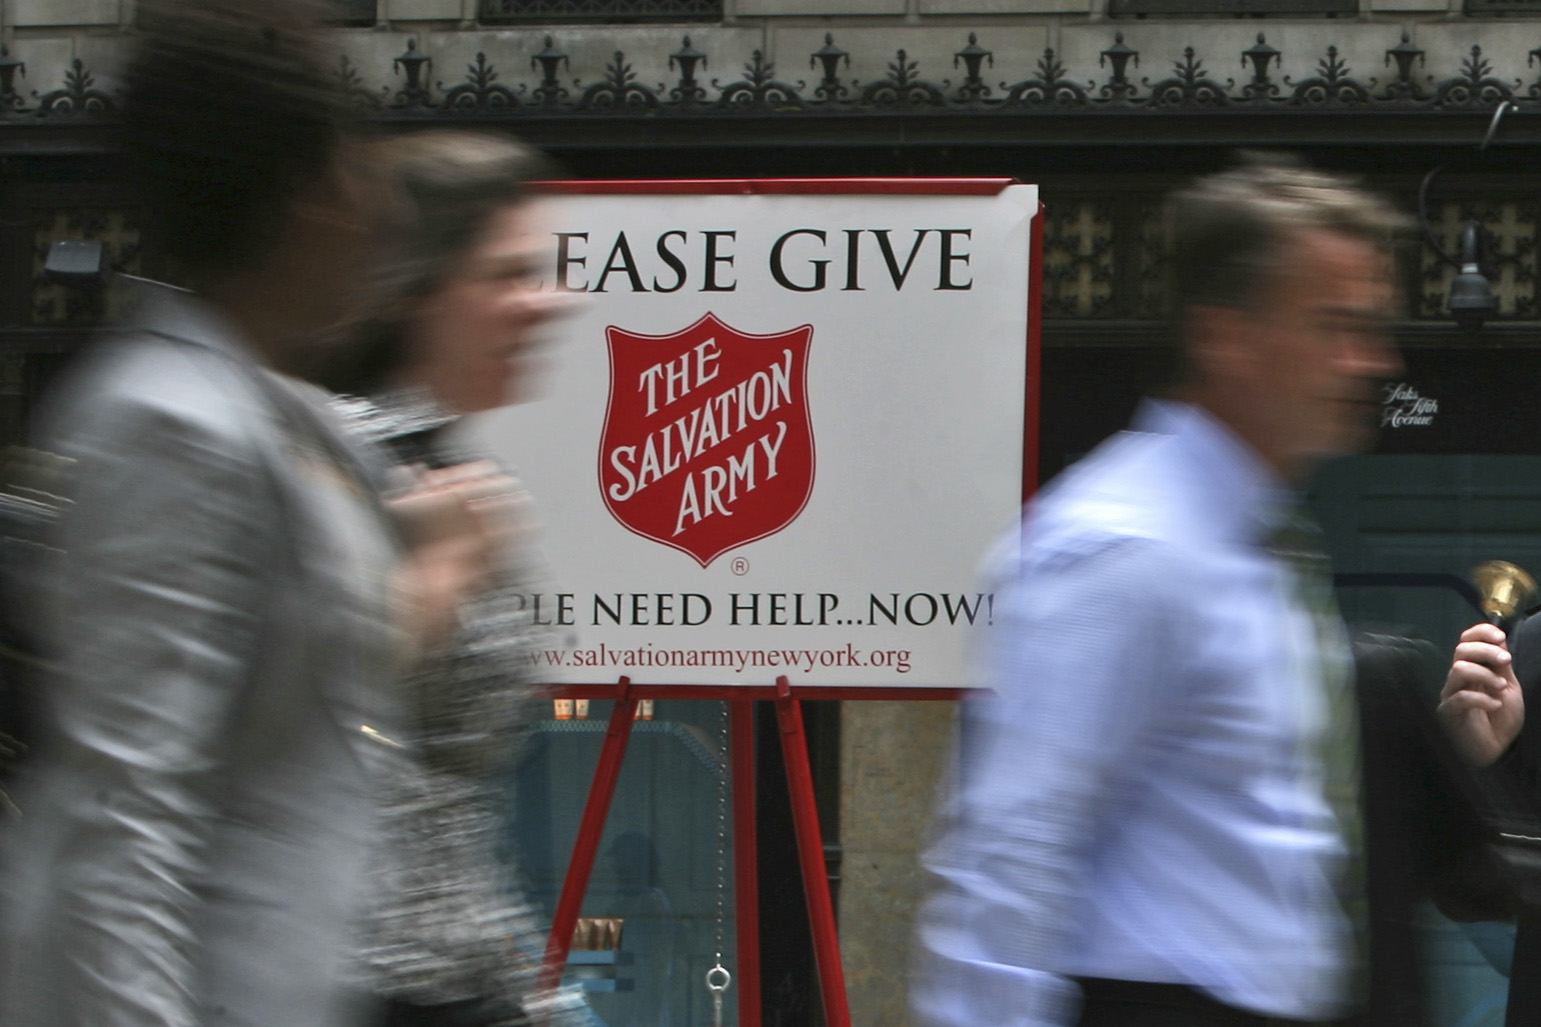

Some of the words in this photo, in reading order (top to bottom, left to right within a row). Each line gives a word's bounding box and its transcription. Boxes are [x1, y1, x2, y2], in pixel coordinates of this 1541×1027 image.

[536, 229, 738, 293] EASE
[769, 228, 974, 293] GIVE
[638, 337, 722, 418] THE
[1383, 384, 1418, 405] Saks
[609, 348, 793, 502] SALVATION
[1380, 406, 1434, 428] Avenue
[1403, 397, 1438, 416] Fifth
[671, 421, 788, 538] ARMY
[591, 592, 713, 627] NEED
